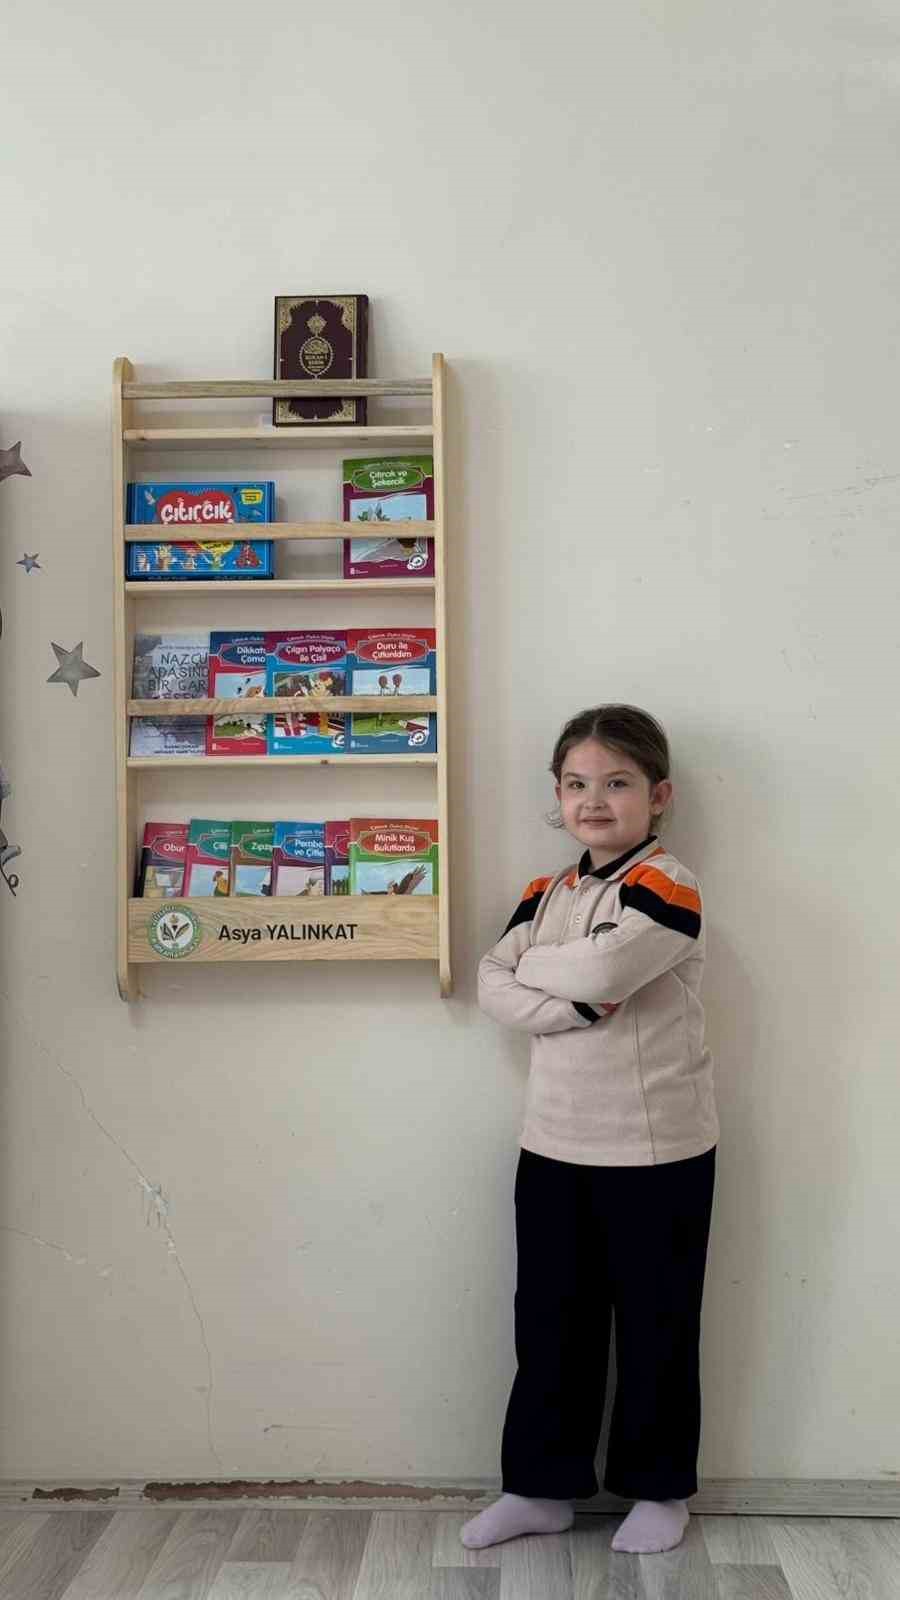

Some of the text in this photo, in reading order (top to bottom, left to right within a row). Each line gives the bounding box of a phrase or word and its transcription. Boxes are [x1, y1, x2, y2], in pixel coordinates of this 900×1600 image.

[376, 642, 397, 651] Duru
[375, 833, 398, 842] Minik
[218, 922, 358, 945] Asya YALINKAT
